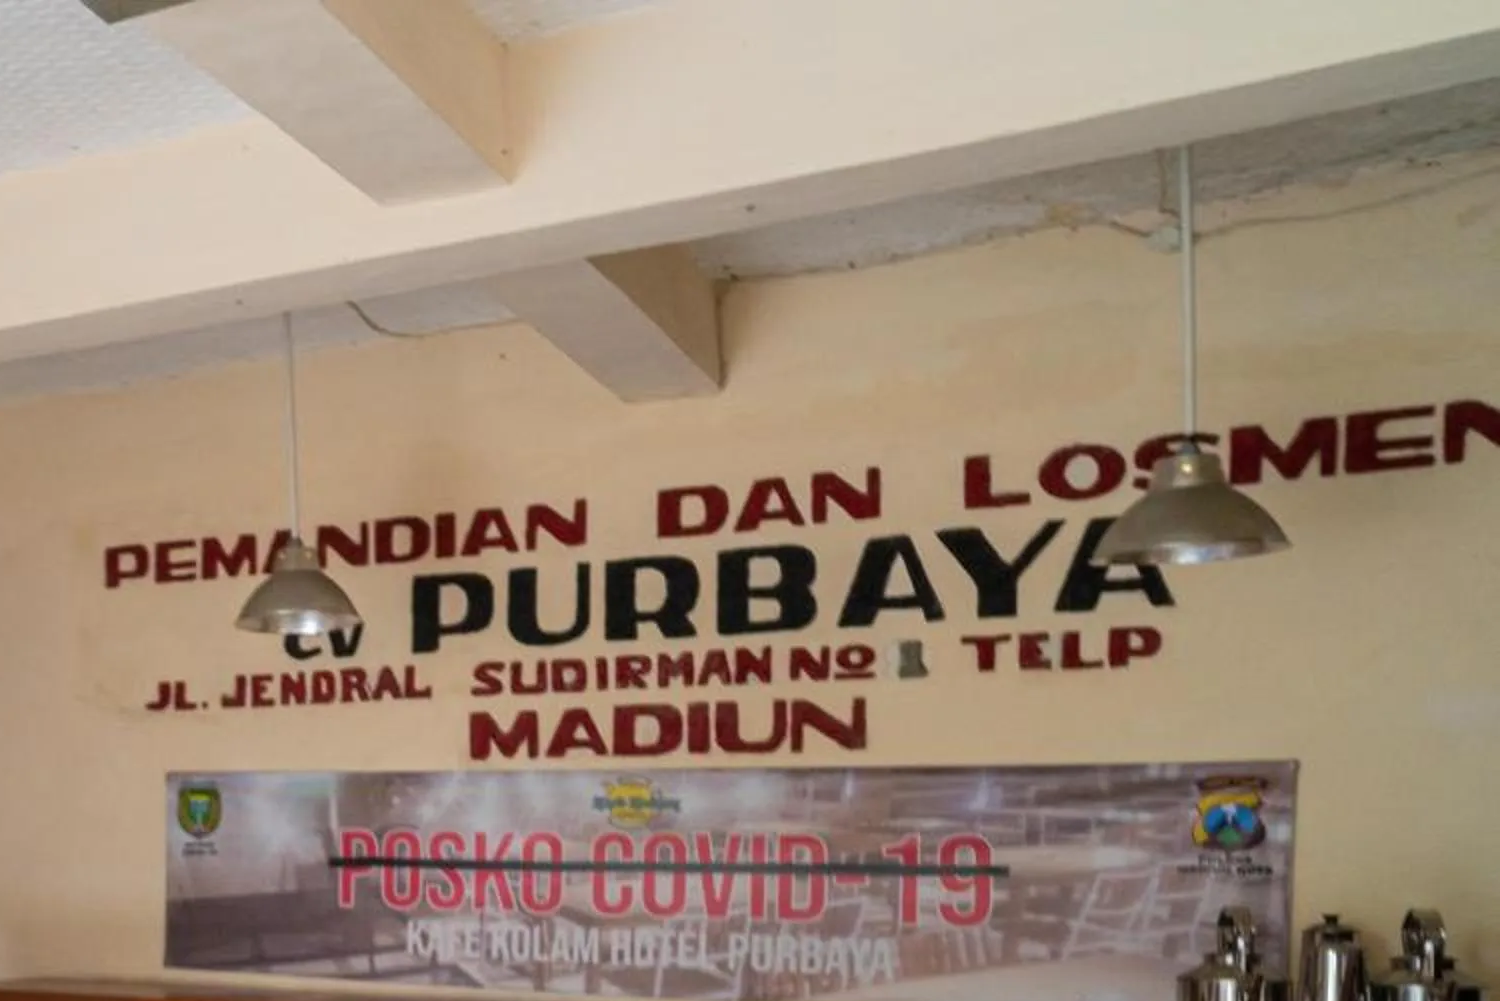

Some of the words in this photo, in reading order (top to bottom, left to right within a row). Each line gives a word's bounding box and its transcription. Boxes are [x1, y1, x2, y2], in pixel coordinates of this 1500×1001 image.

[656, 467, 882, 538] DAN
[412, 517, 1175, 653] PURBAYA
[146, 680, 208, 711] JL.
[220, 664, 432, 708] JENDRAL
[471, 646, 772, 697] SUDIRMAN
[961, 626, 1162, 672] TELP
[469, 696, 867, 760] MADIUN
[338, 827, 563, 915] POSKO
[491, 924, 600, 964] KOLAM
[610, 926, 712, 970] HOTEL
[728, 932, 894, 981] PURBAYA
